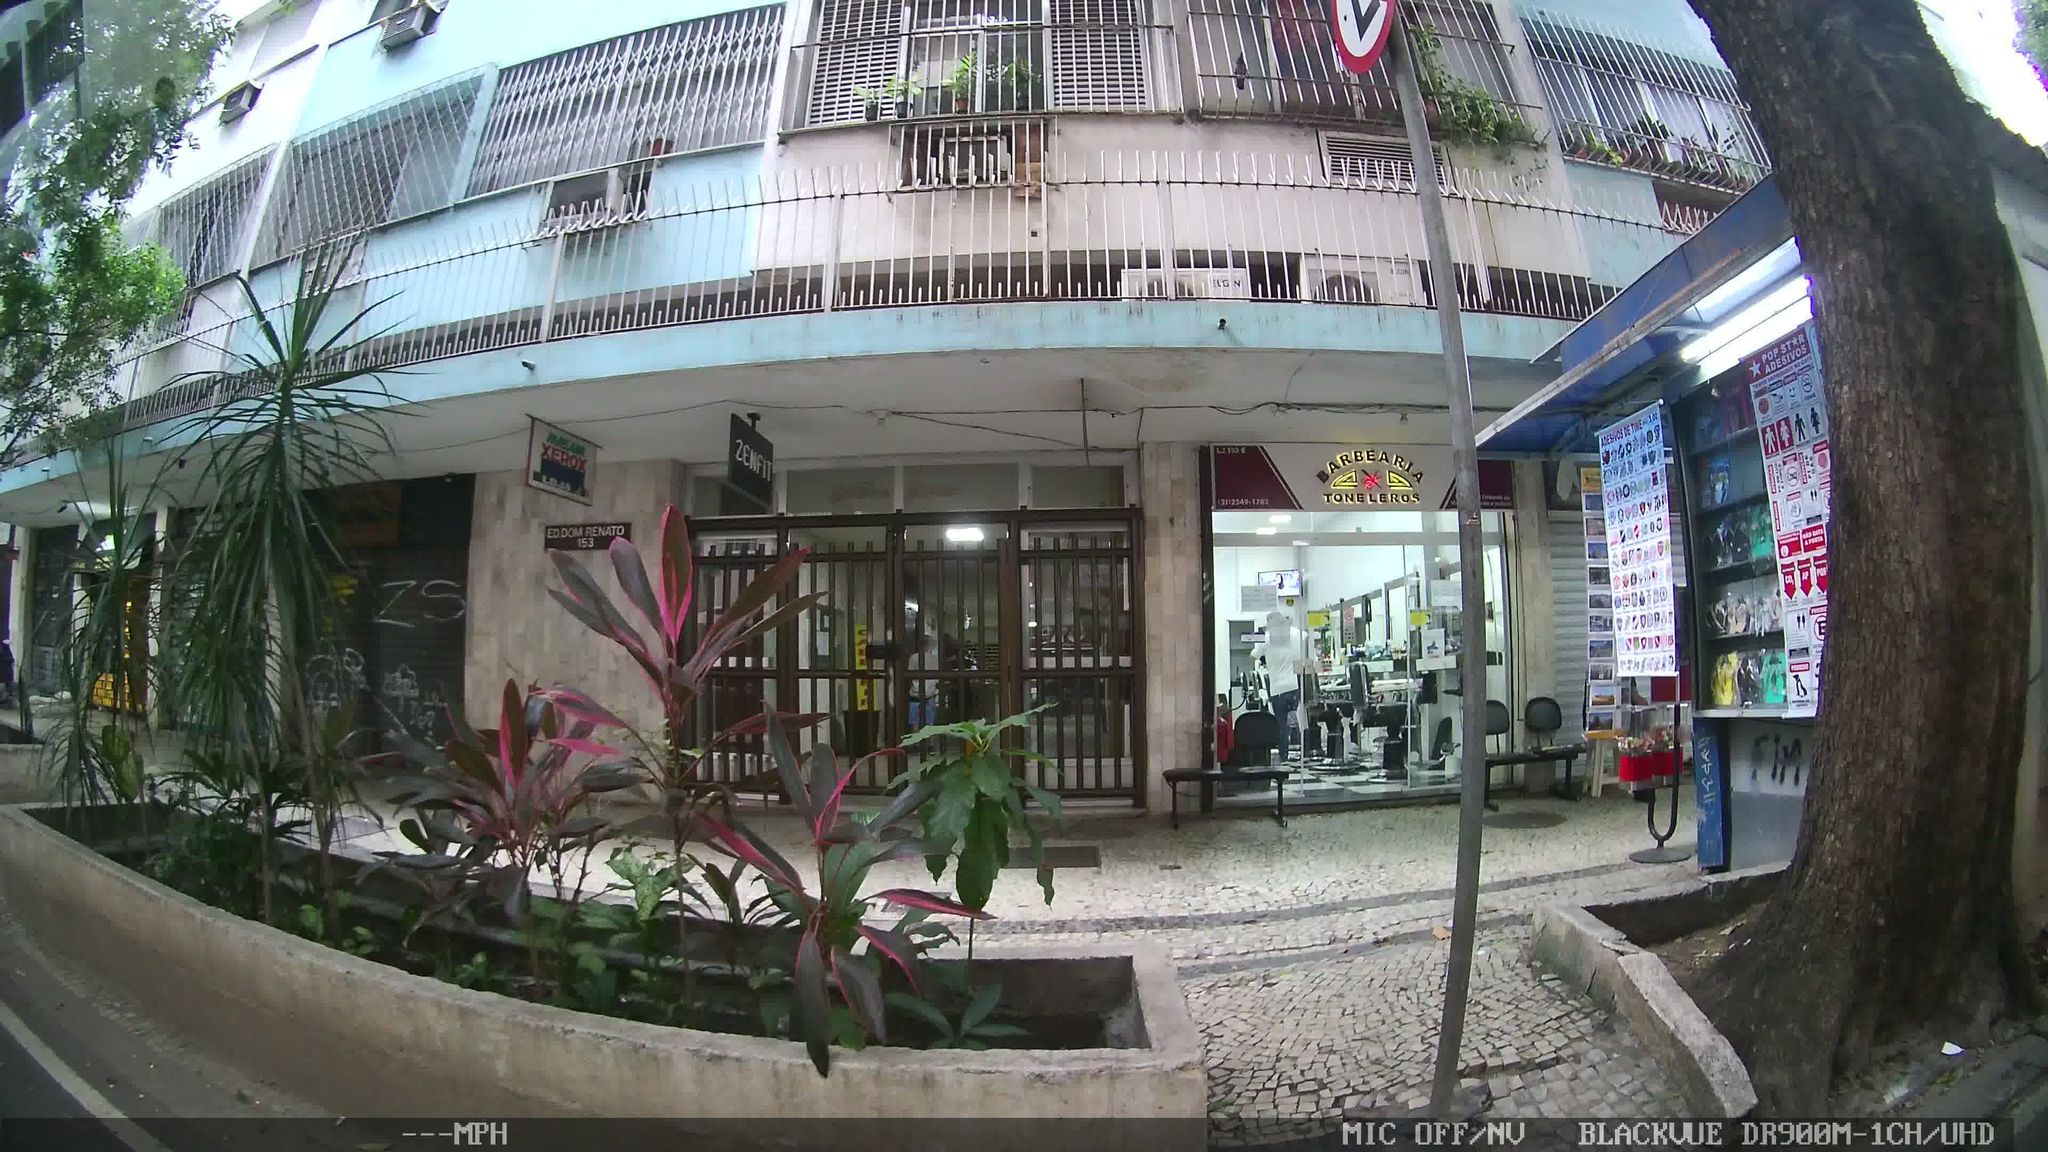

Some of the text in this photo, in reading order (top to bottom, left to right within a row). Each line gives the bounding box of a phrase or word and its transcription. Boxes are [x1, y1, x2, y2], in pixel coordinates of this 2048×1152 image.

[1212, 279, 1241, 288] ELGN
[1761, 347, 1779, 364] POP
[1765, 344, 1808, 375] ADESIVOS
[541, 441, 587, 473] XEROX
[1316, 449, 1424, 485] BARBEARIA
[1323, 492, 1421, 504] TONELEROS
[585, 525, 625, 537] RENATO
[577, 537, 594, 548] 153
